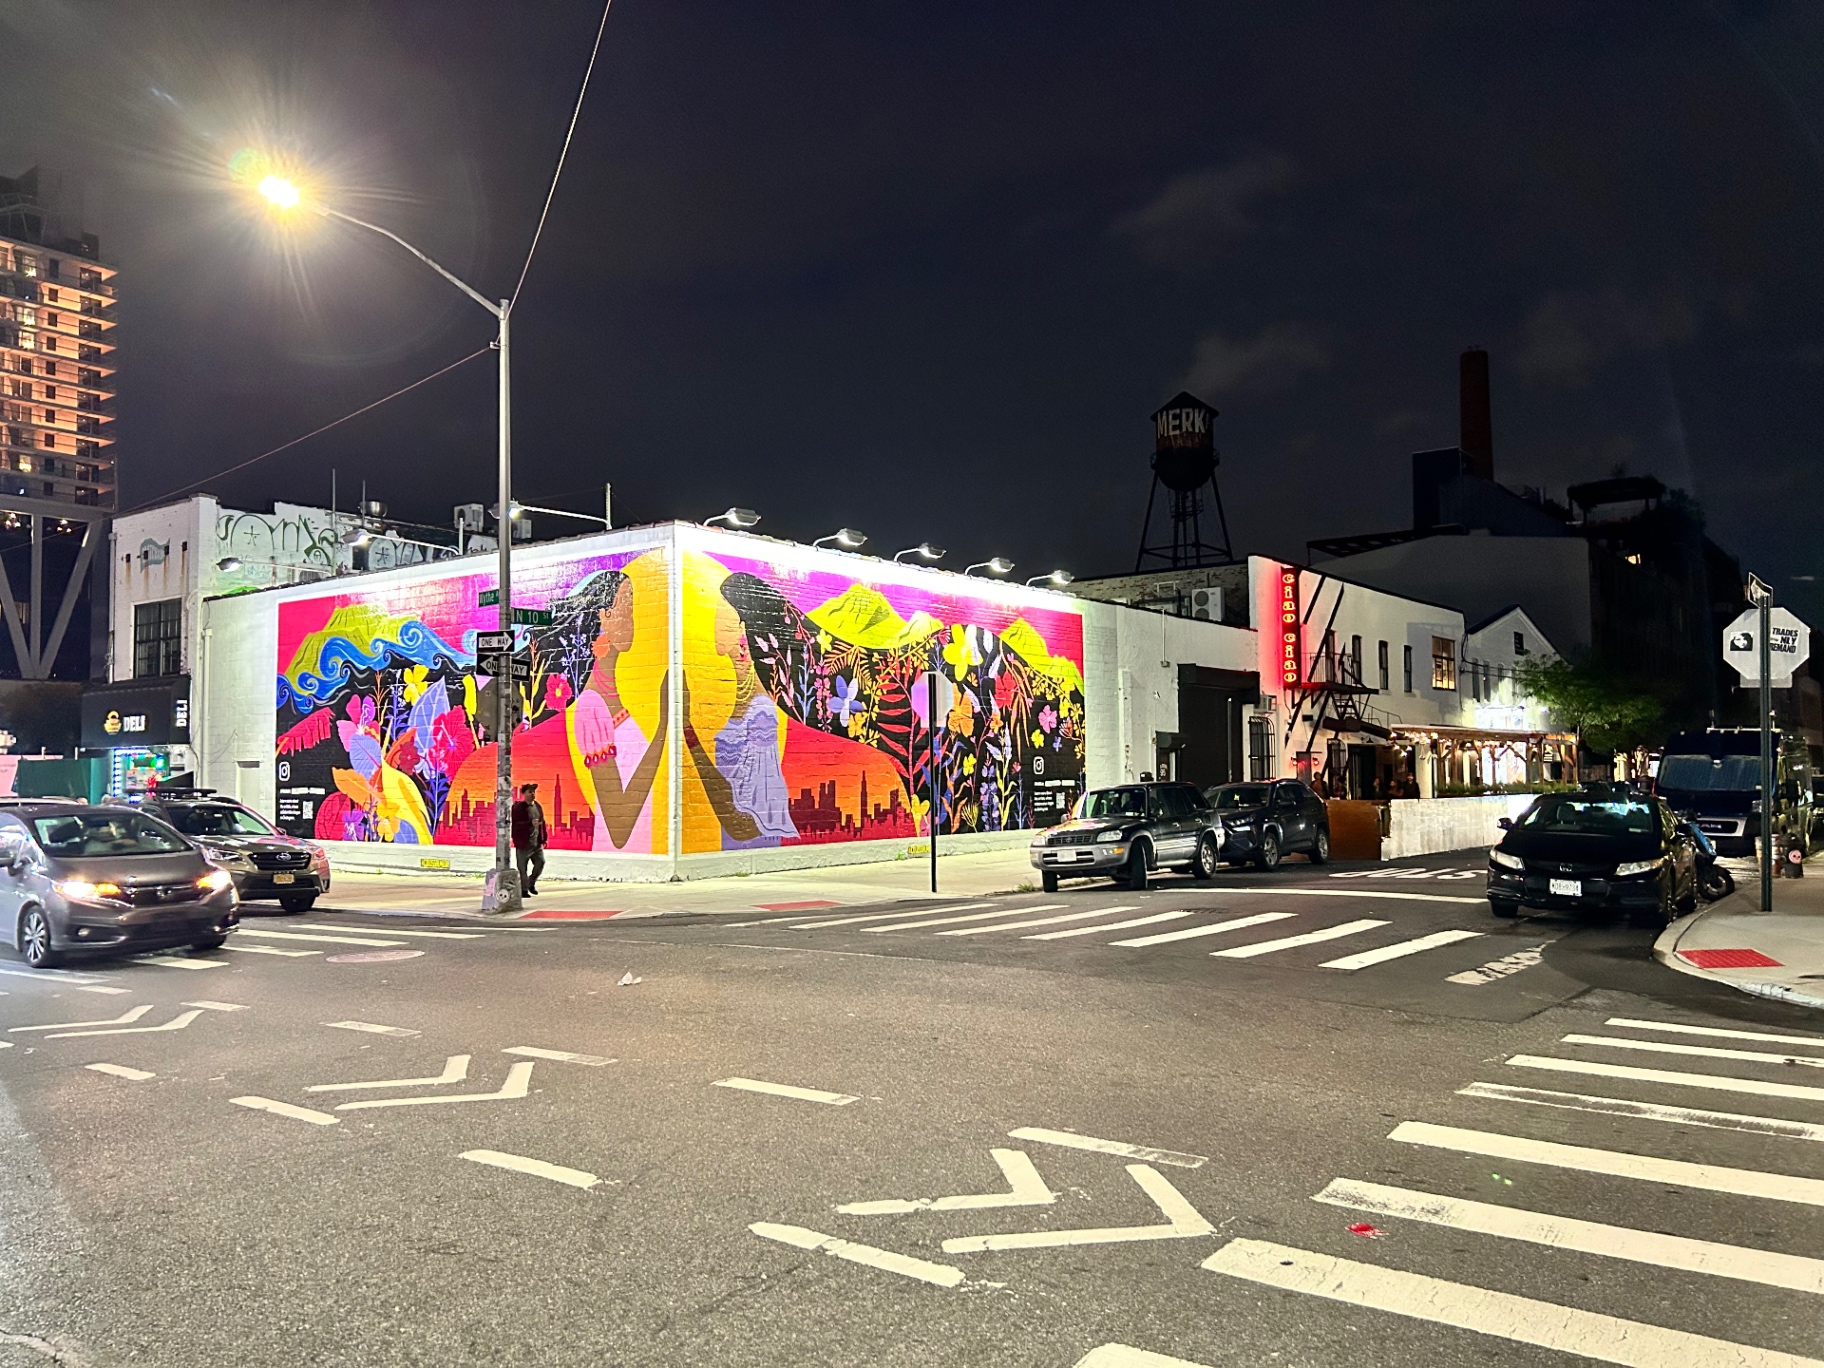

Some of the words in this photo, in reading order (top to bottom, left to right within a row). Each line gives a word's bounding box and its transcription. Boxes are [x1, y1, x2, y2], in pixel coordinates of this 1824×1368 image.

[1282, 573, 1296, 623] ciao
[516, 609, 523, 623] N
[527, 610, 539, 624] 10
[481, 637, 493, 647] ONE
[497, 637, 509, 646] WAY
[1283, 633, 1297, 682] ciao
[123, 714, 146, 733] DELI
[175, 699, 188, 728] DELI
